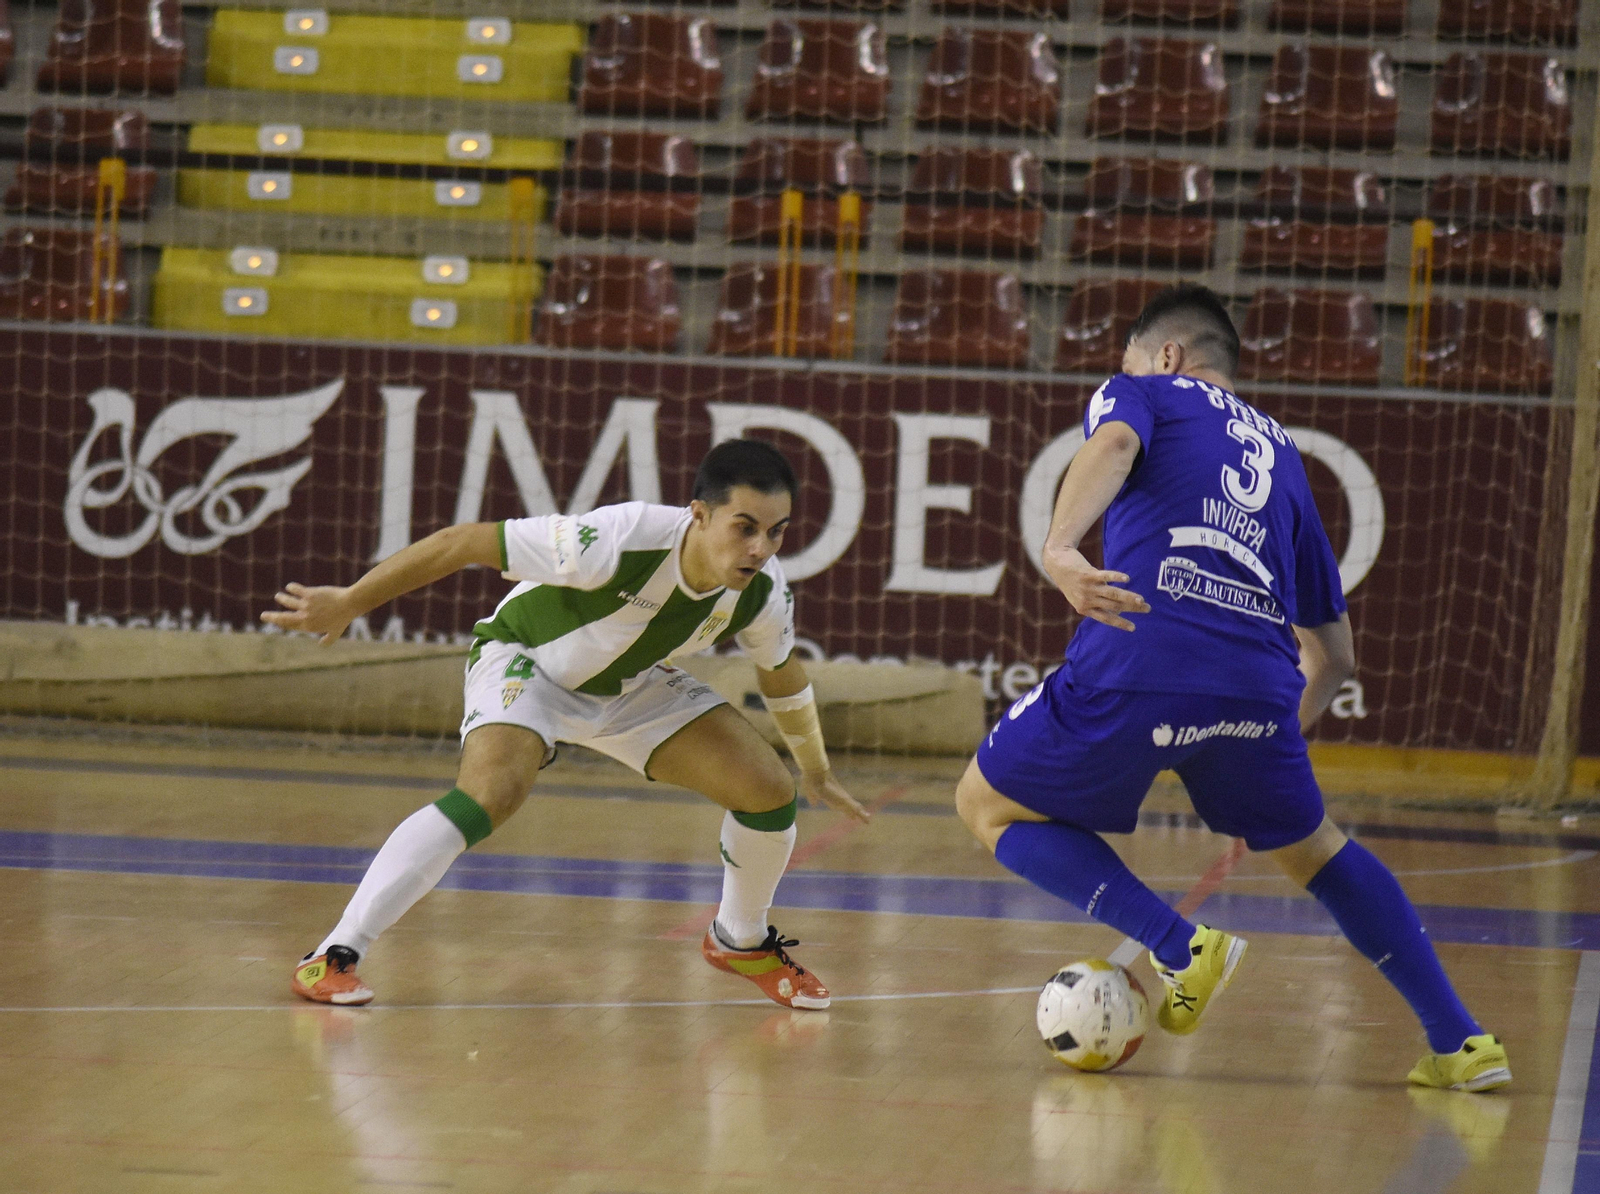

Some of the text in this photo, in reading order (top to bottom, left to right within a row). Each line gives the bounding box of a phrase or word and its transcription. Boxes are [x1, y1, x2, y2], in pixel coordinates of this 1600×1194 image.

[1221, 418, 1274, 513] 3
[1203, 497, 1266, 554] INVIRPA
[1200, 532, 1257, 569] HORECA
[501, 652, 537, 680] 4
